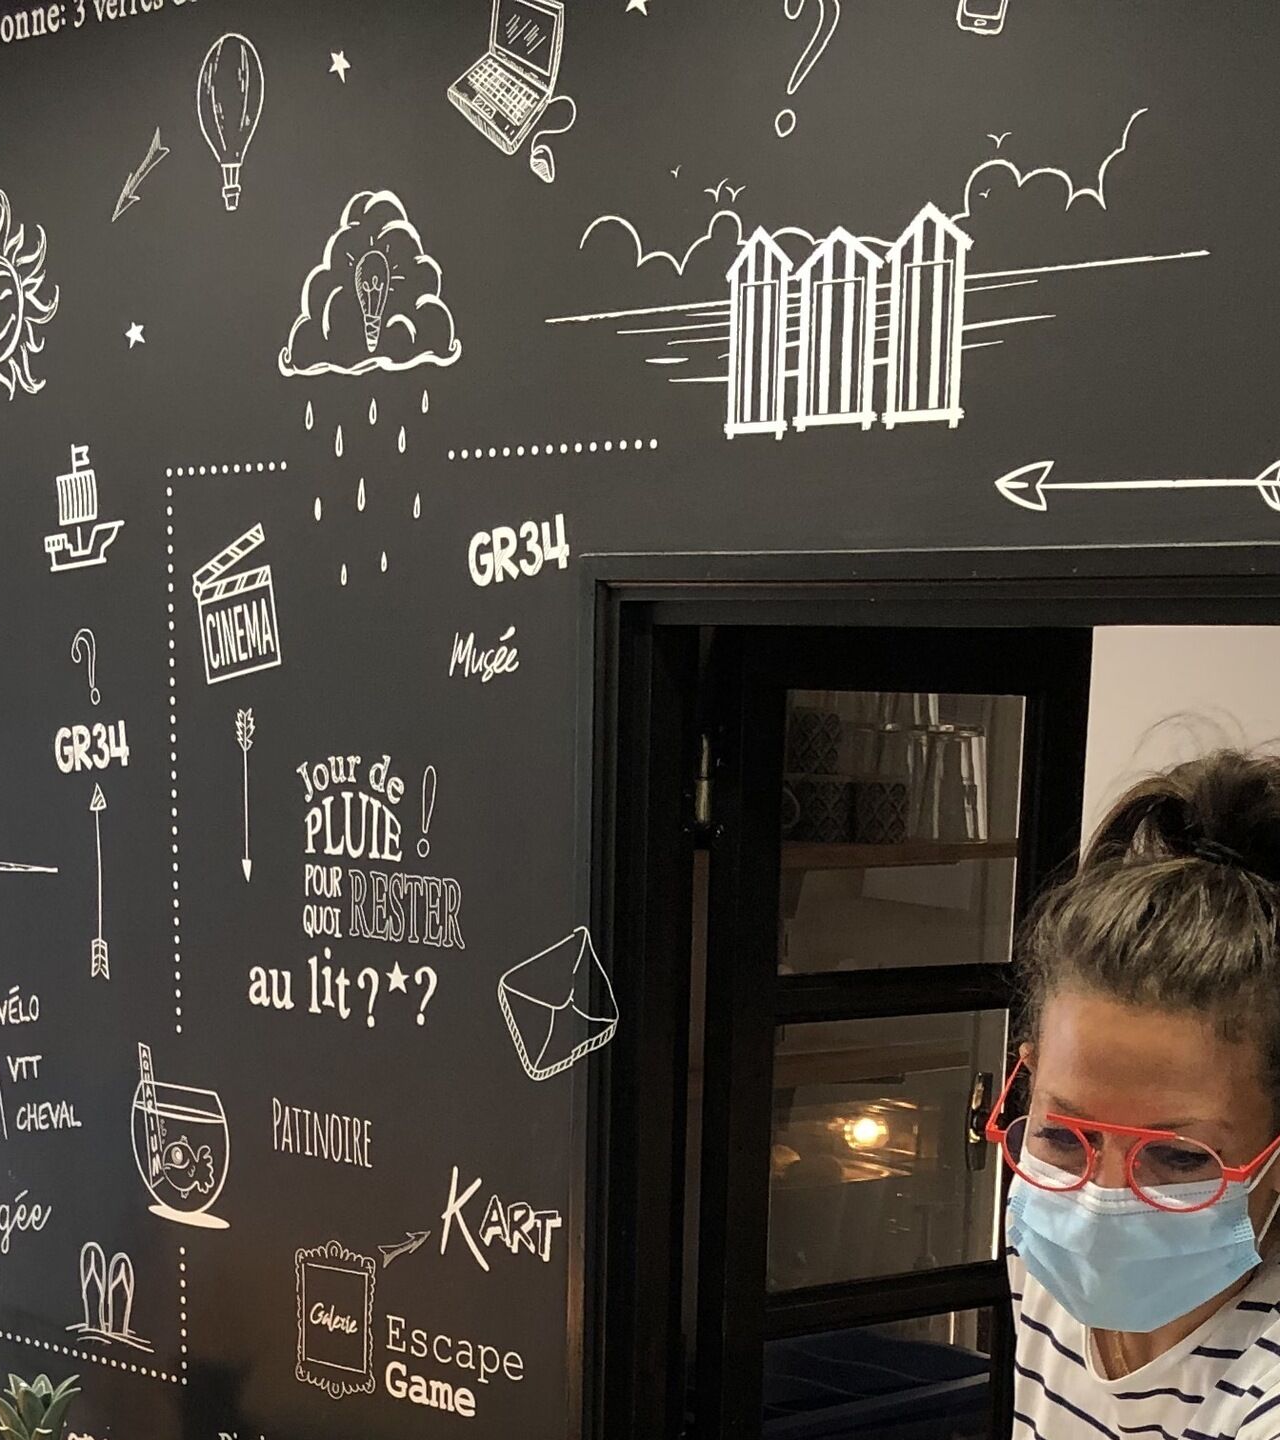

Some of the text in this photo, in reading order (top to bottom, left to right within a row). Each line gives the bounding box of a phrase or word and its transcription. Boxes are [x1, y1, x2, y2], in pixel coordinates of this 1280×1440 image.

[468, 513, 570, 587] GR34
[205, 598, 275, 670] CINEMA
[449, 625, 520, 683] Musée
[54, 720, 131, 774] GR34
[296, 755, 406, 805] Jour de
[304, 791, 403, 862] PLUIE
[304, 864, 343, 898] POUR
[348, 869, 465, 950] RESTER
[303, 904, 343, 939] QUOI
[248, 965, 295, 1009] au
[6, 1054, 43, 1082] VTT
[16, 1100, 83, 1132] CHEVAL
[272, 1097, 373, 1168] PATINOIRE
[385, 1313, 524, 1384] Escape
[384, 1360, 476, 1417] Game
